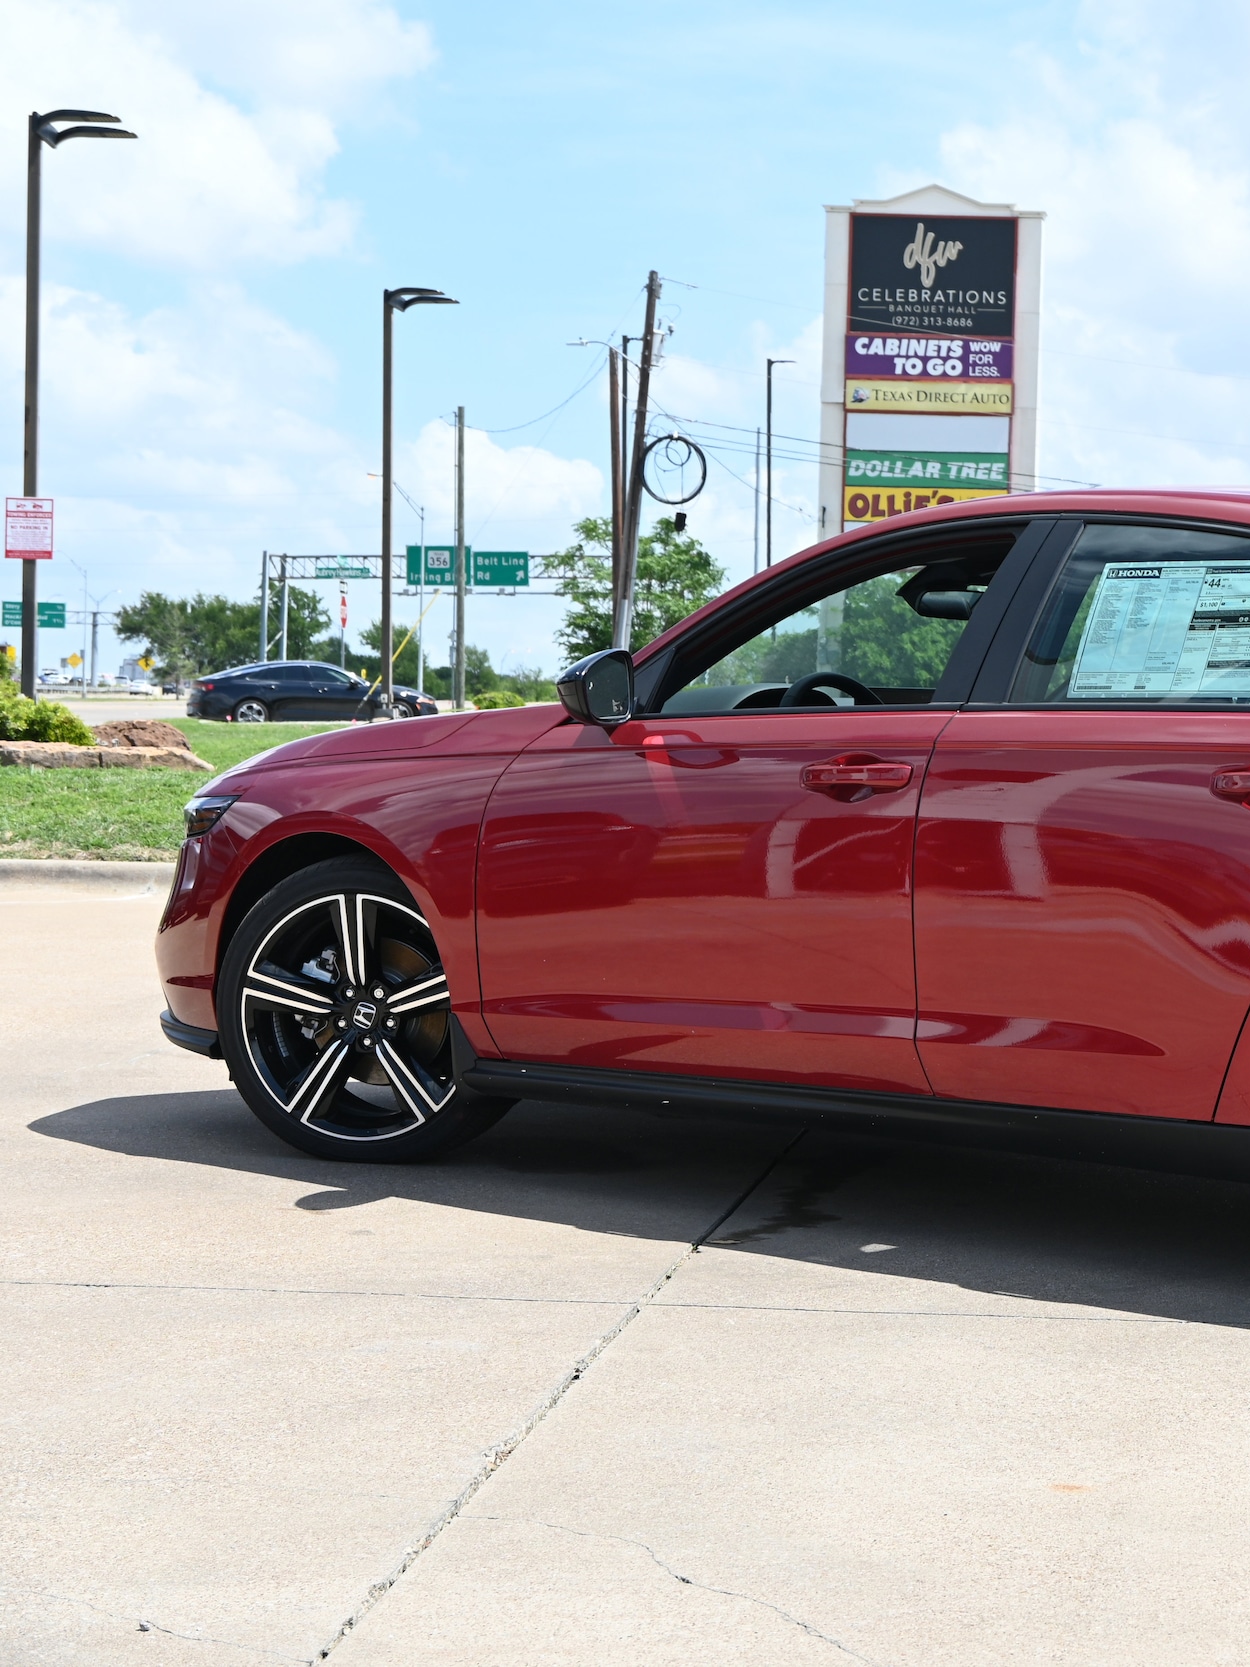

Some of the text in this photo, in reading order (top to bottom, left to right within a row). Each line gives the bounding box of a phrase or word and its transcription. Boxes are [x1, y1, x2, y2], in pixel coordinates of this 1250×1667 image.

[857, 287, 1007, 305] CELEBRATIONS
[888, 304, 977, 314] BANQUET HALL
[892, 316, 973, 327] (972) 313-8686
[854, 336, 964, 358] CABINETS
[968, 341, 1002, 353] WOW
[968, 354, 993, 364] FOR
[893, 357, 964, 376] TO GO
[968, 366, 1001, 377] LESS.
[872, 388, 1010, 405] TEXAS DIRECT AUTO
[848, 459, 1006, 480] DOLLAR TREE
[429, 556, 448, 567] 356
[477, 556, 525, 566] Belt Line
[477, 571, 490, 581] Rd
[1117, 569, 1160, 577] HONDA
[1208, 578, 1221, 588] 44
